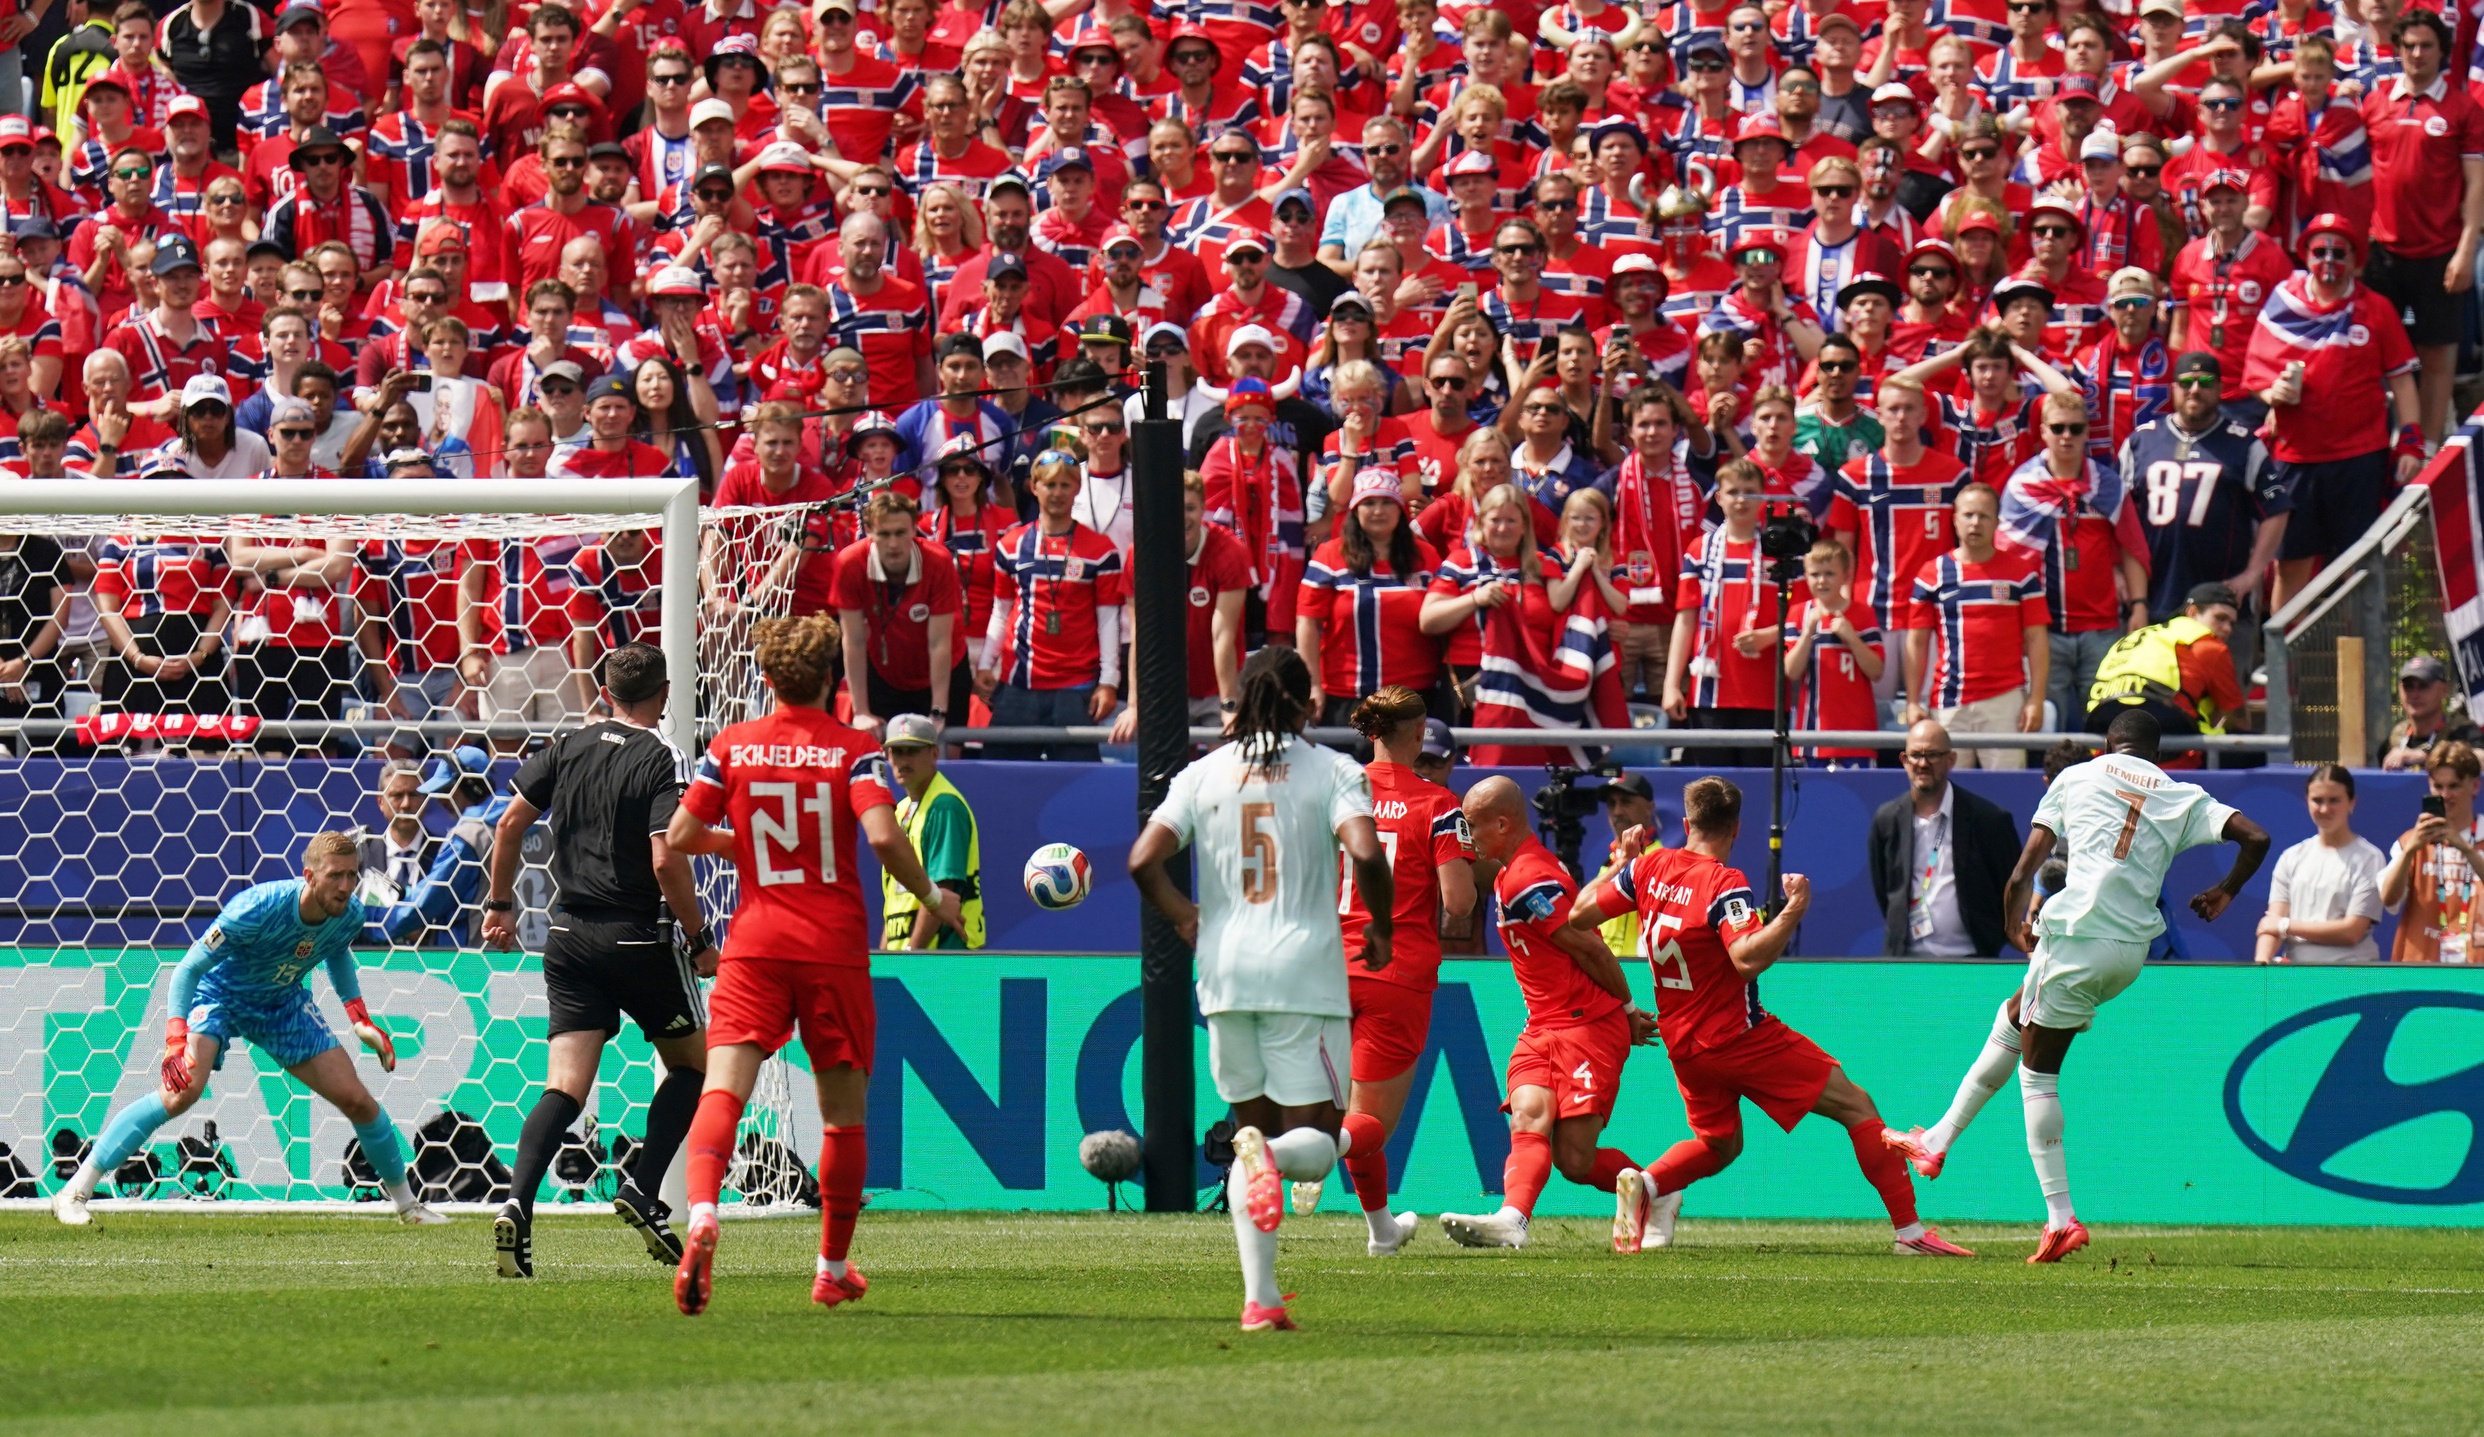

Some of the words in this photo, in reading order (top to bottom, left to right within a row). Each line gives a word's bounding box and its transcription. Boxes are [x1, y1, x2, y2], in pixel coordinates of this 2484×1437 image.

[271, 165, 295, 198] 10
[2146, 460, 2223, 527] 87
[729, 744, 848, 769] SCHJELDERUP
[1372, 800, 1408, 820] AARD
[2112, 788, 2147, 861] 7
[749, 781, 838, 887] 21
[1241, 802, 1278, 905] 5
[1509, 929, 1530, 957] 4
[1643, 909, 1694, 992] 15
[271, 962, 301, 987] 13
[1573, 1060, 1593, 1089] 4
